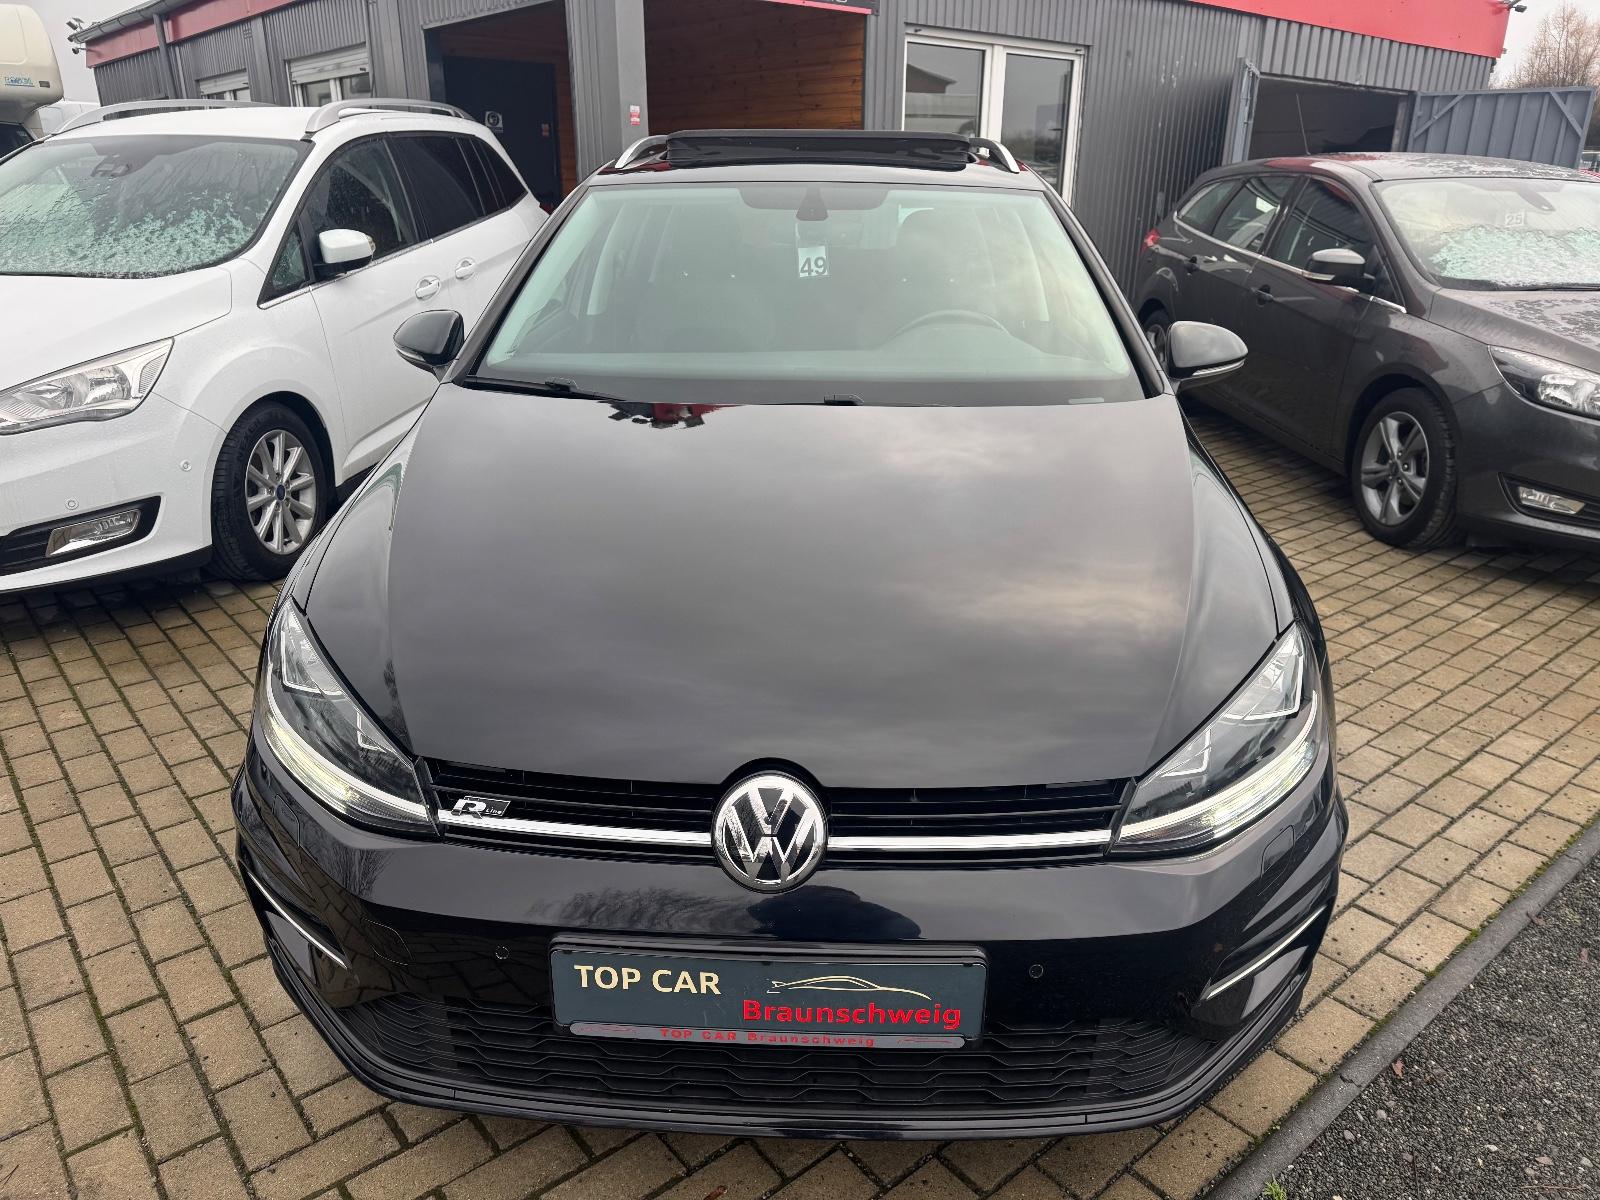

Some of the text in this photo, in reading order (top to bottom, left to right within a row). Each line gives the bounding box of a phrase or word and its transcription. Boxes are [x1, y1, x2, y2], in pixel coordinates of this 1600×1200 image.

[800, 256, 827, 275] 49
[451, 799, 502, 818] R Line
[573, 964, 722, 995] TOP CAR
[742, 999, 962, 1031] Braunschweig
[659, 1028, 875, 1048] TOP CAR Braunschweig
